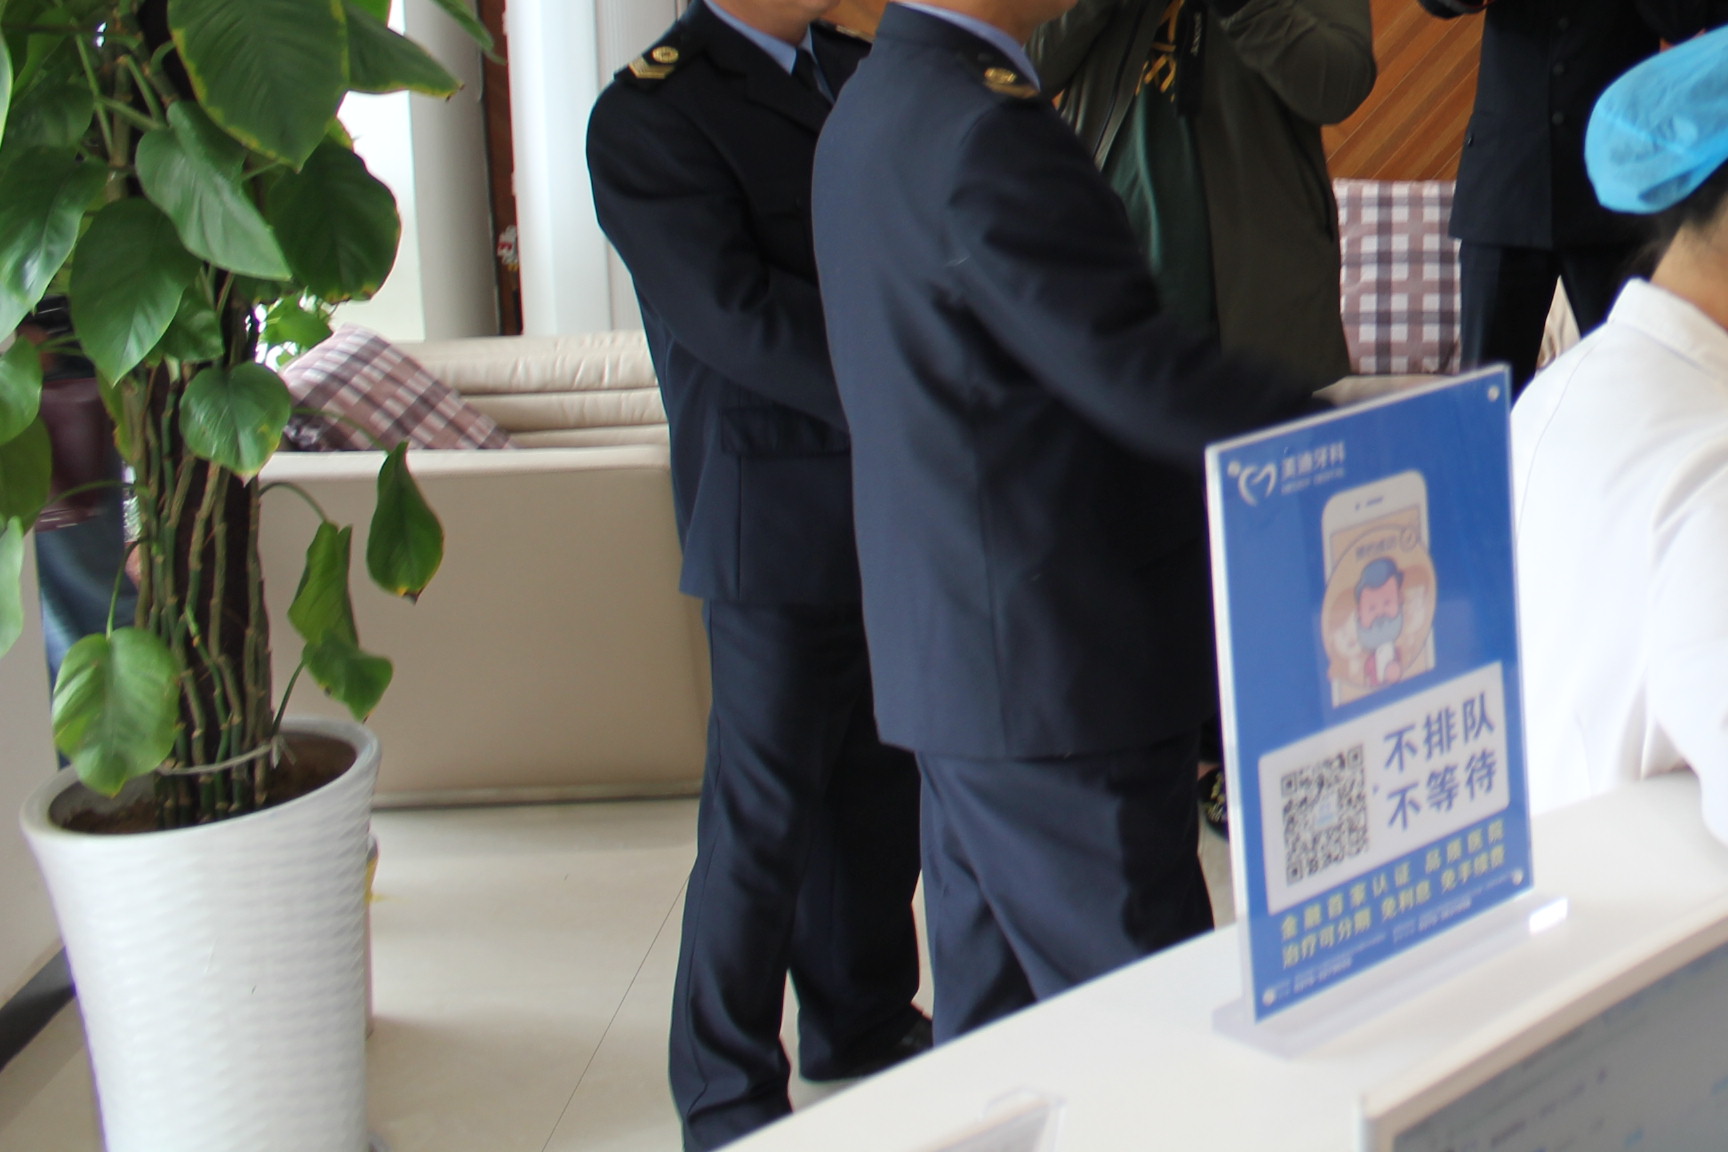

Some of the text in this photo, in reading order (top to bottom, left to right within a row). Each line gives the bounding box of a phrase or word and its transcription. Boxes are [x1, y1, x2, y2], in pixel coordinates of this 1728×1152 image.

[1384, 691, 1494, 771] 不排队
[1386, 748, 1497, 830] 不等待
